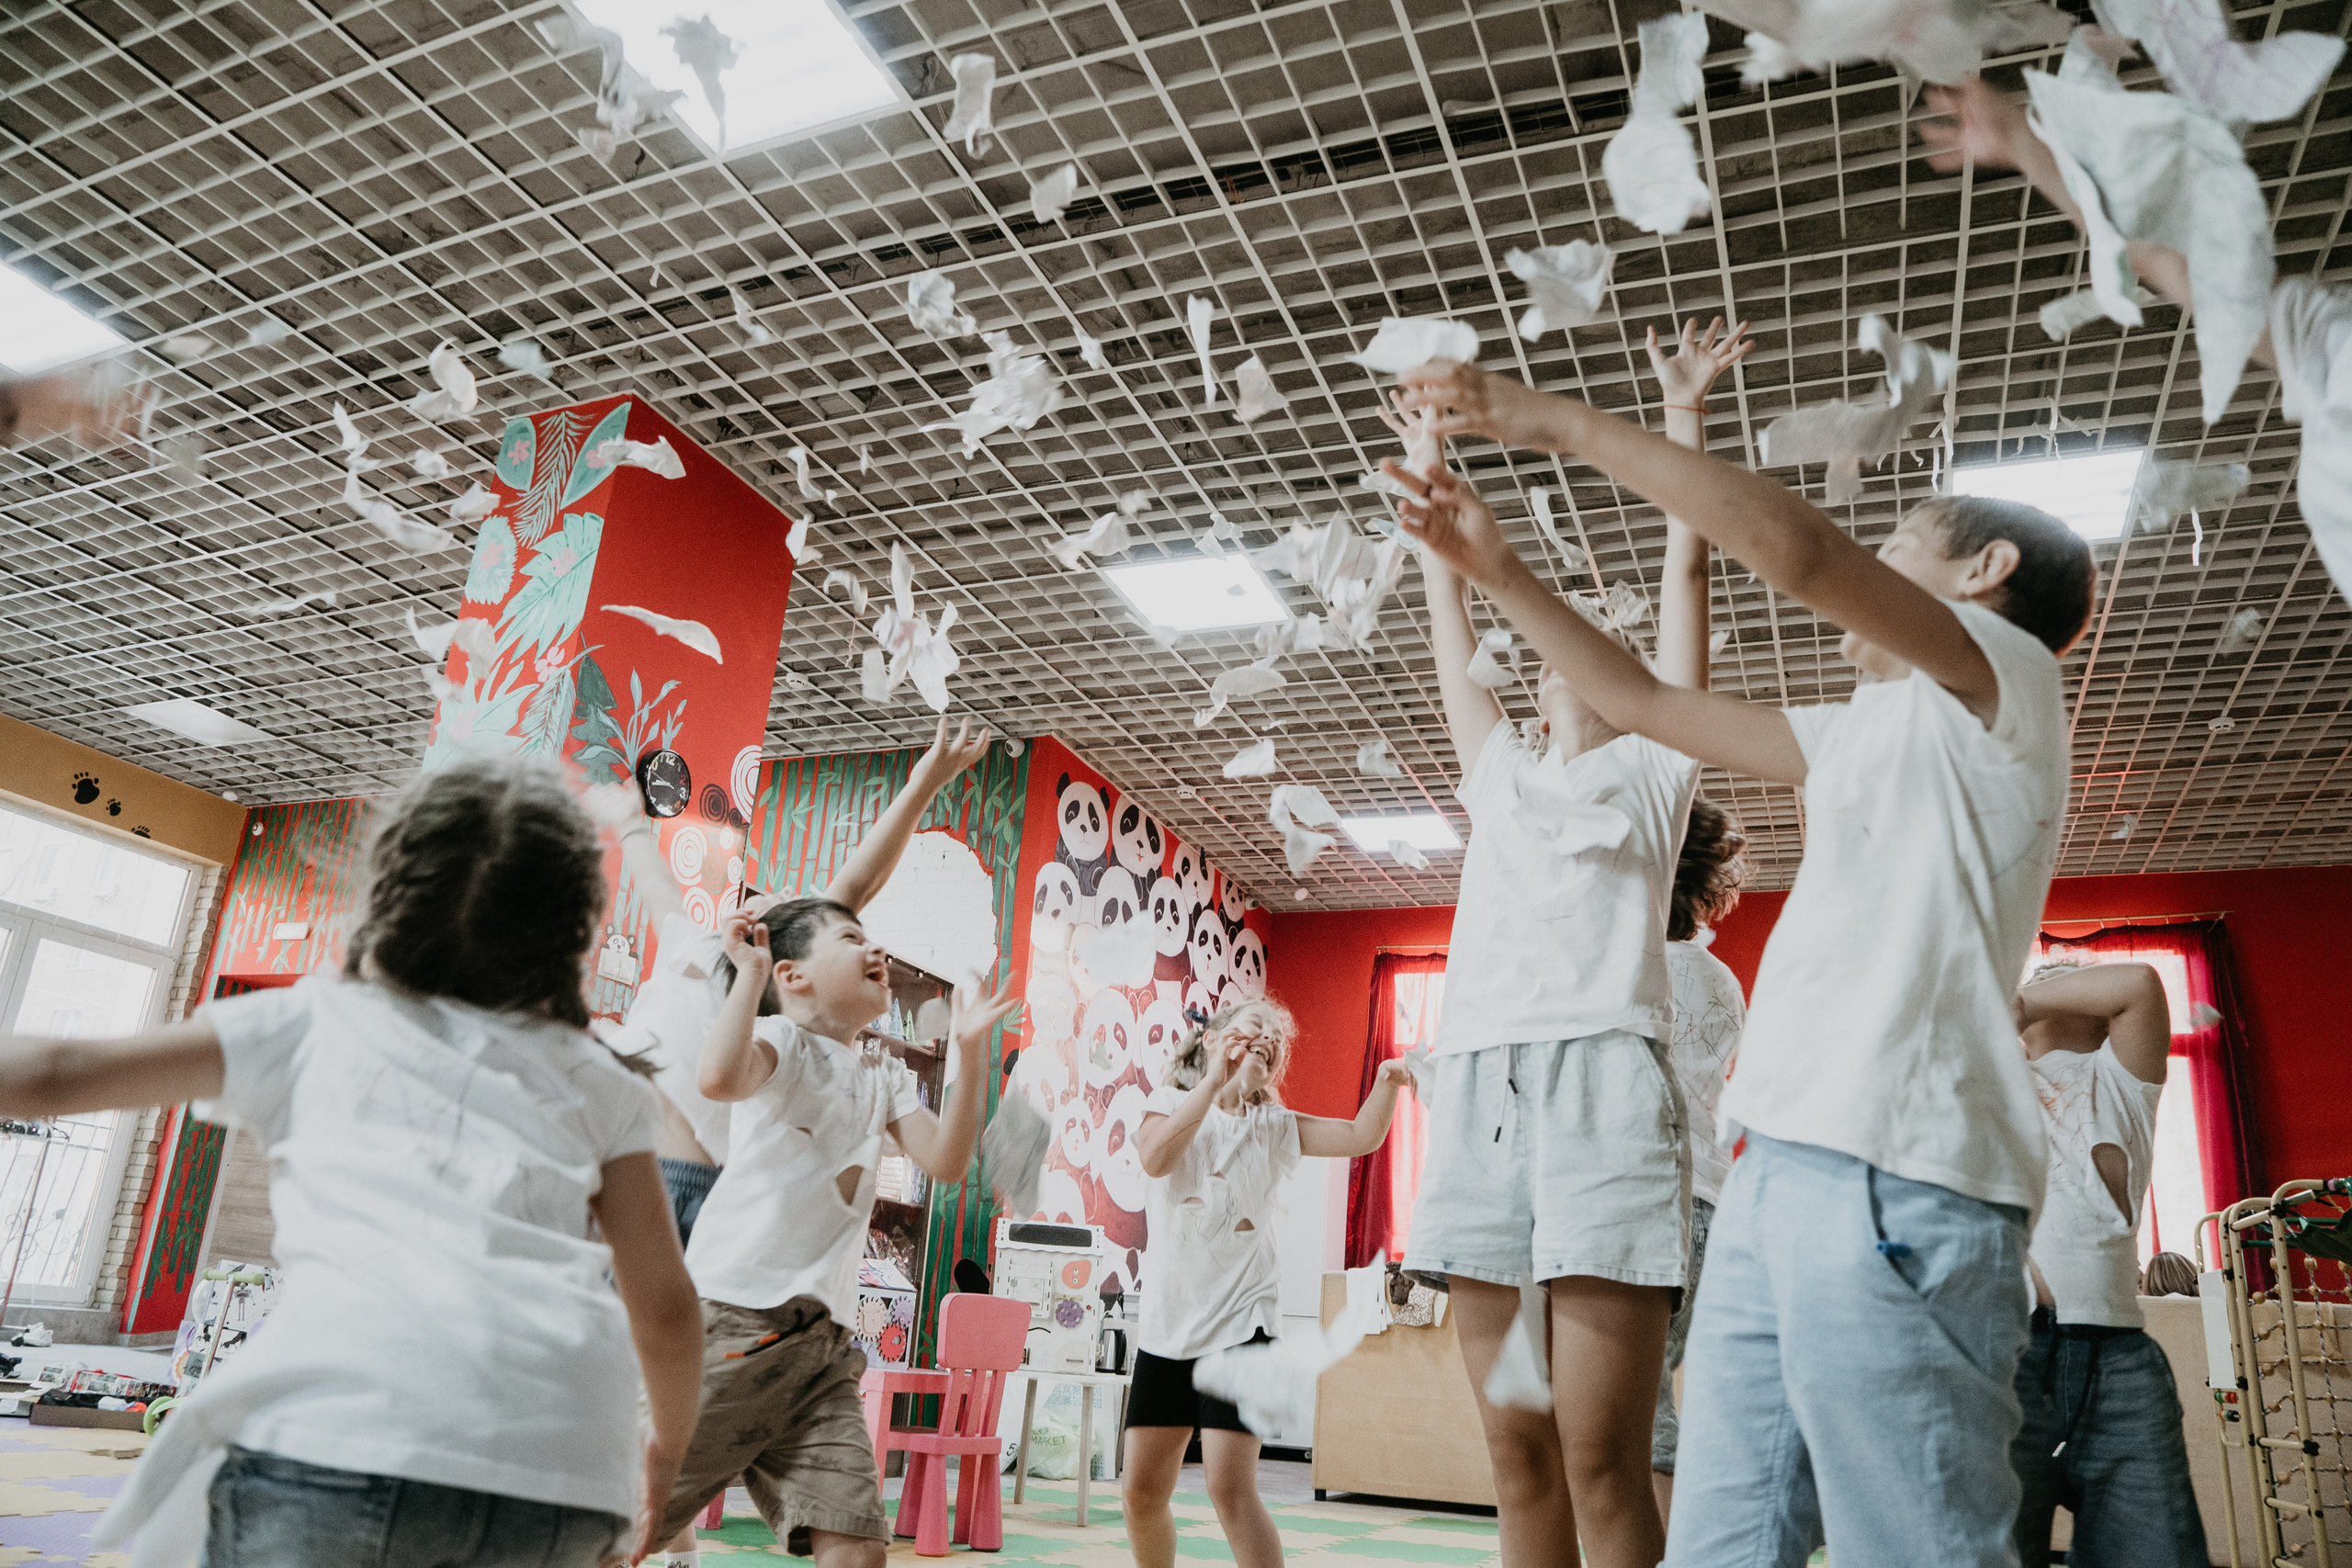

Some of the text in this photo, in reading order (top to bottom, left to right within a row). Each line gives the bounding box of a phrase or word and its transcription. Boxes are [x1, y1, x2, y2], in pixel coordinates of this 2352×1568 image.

[665, 754, 675, 766] 12
[680, 786, 686, 799] 3
[1031, 1435, 1067, 1446] MARKET
